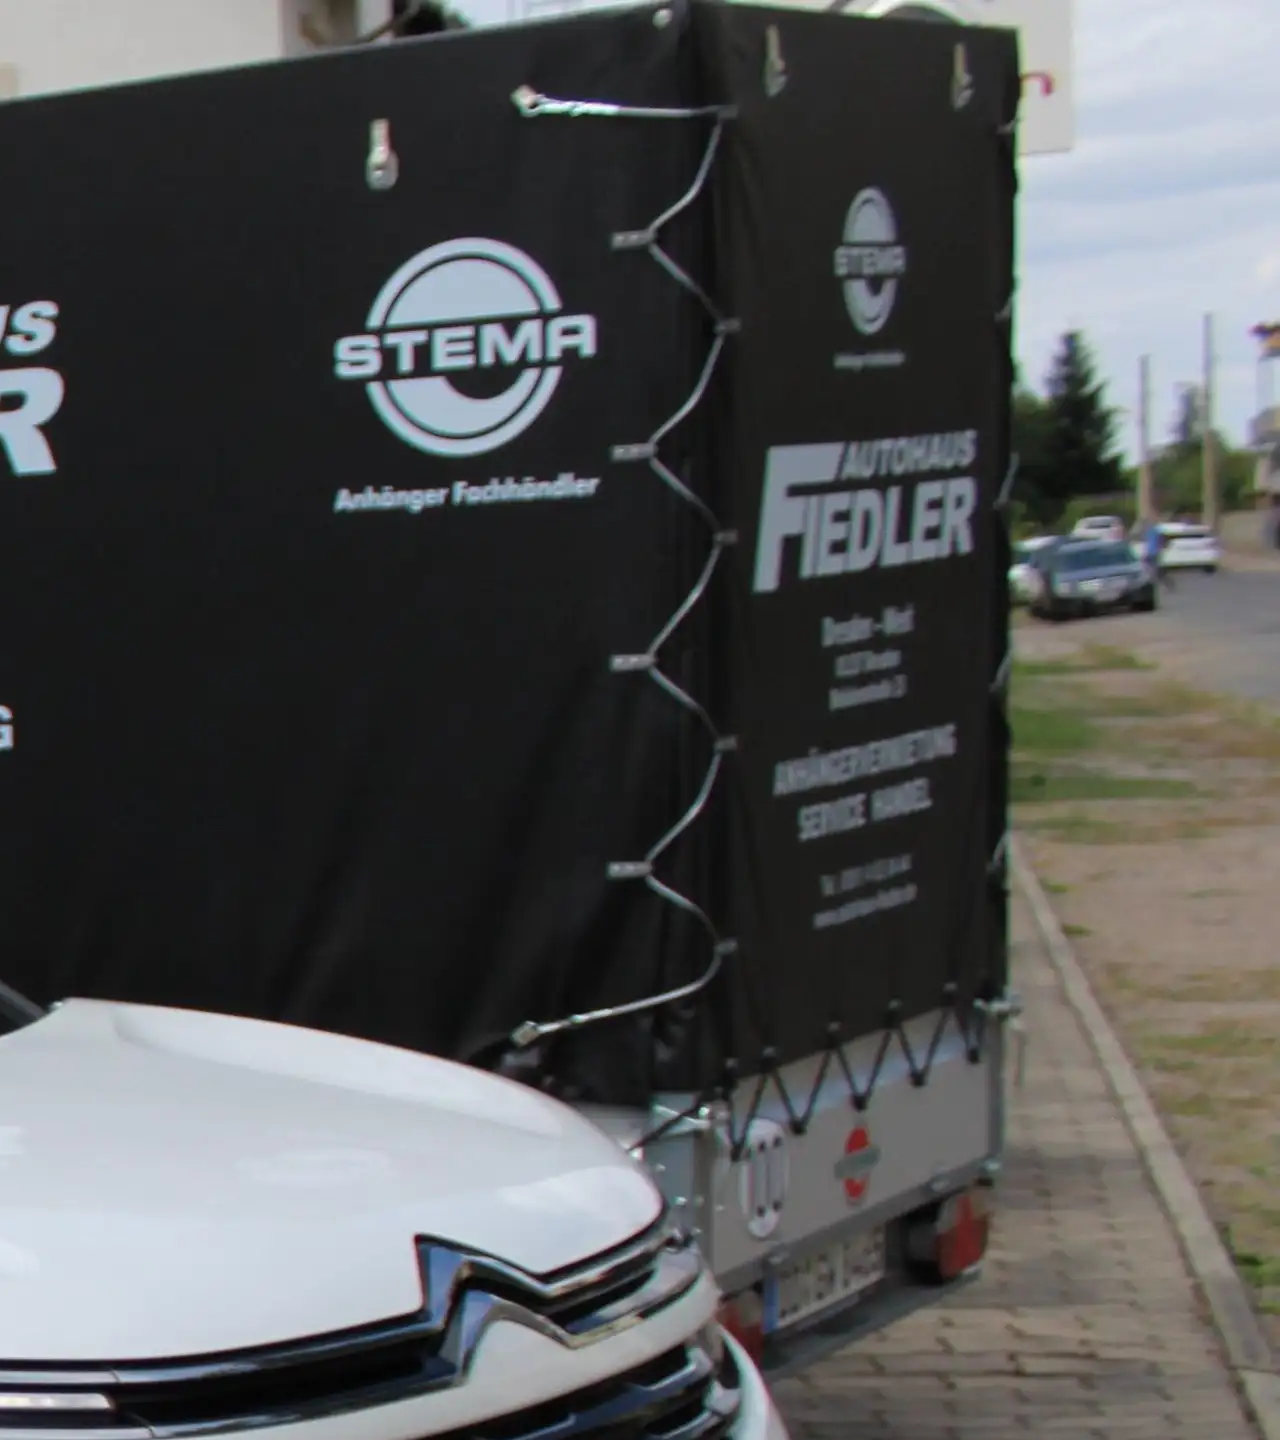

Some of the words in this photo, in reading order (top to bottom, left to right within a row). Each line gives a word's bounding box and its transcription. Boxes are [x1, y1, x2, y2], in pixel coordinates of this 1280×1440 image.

[333, 313, 597, 380] STEMA
[841, 430, 979, 480] AUTOHAUS
[752, 441, 978, 595] FIEDLER
